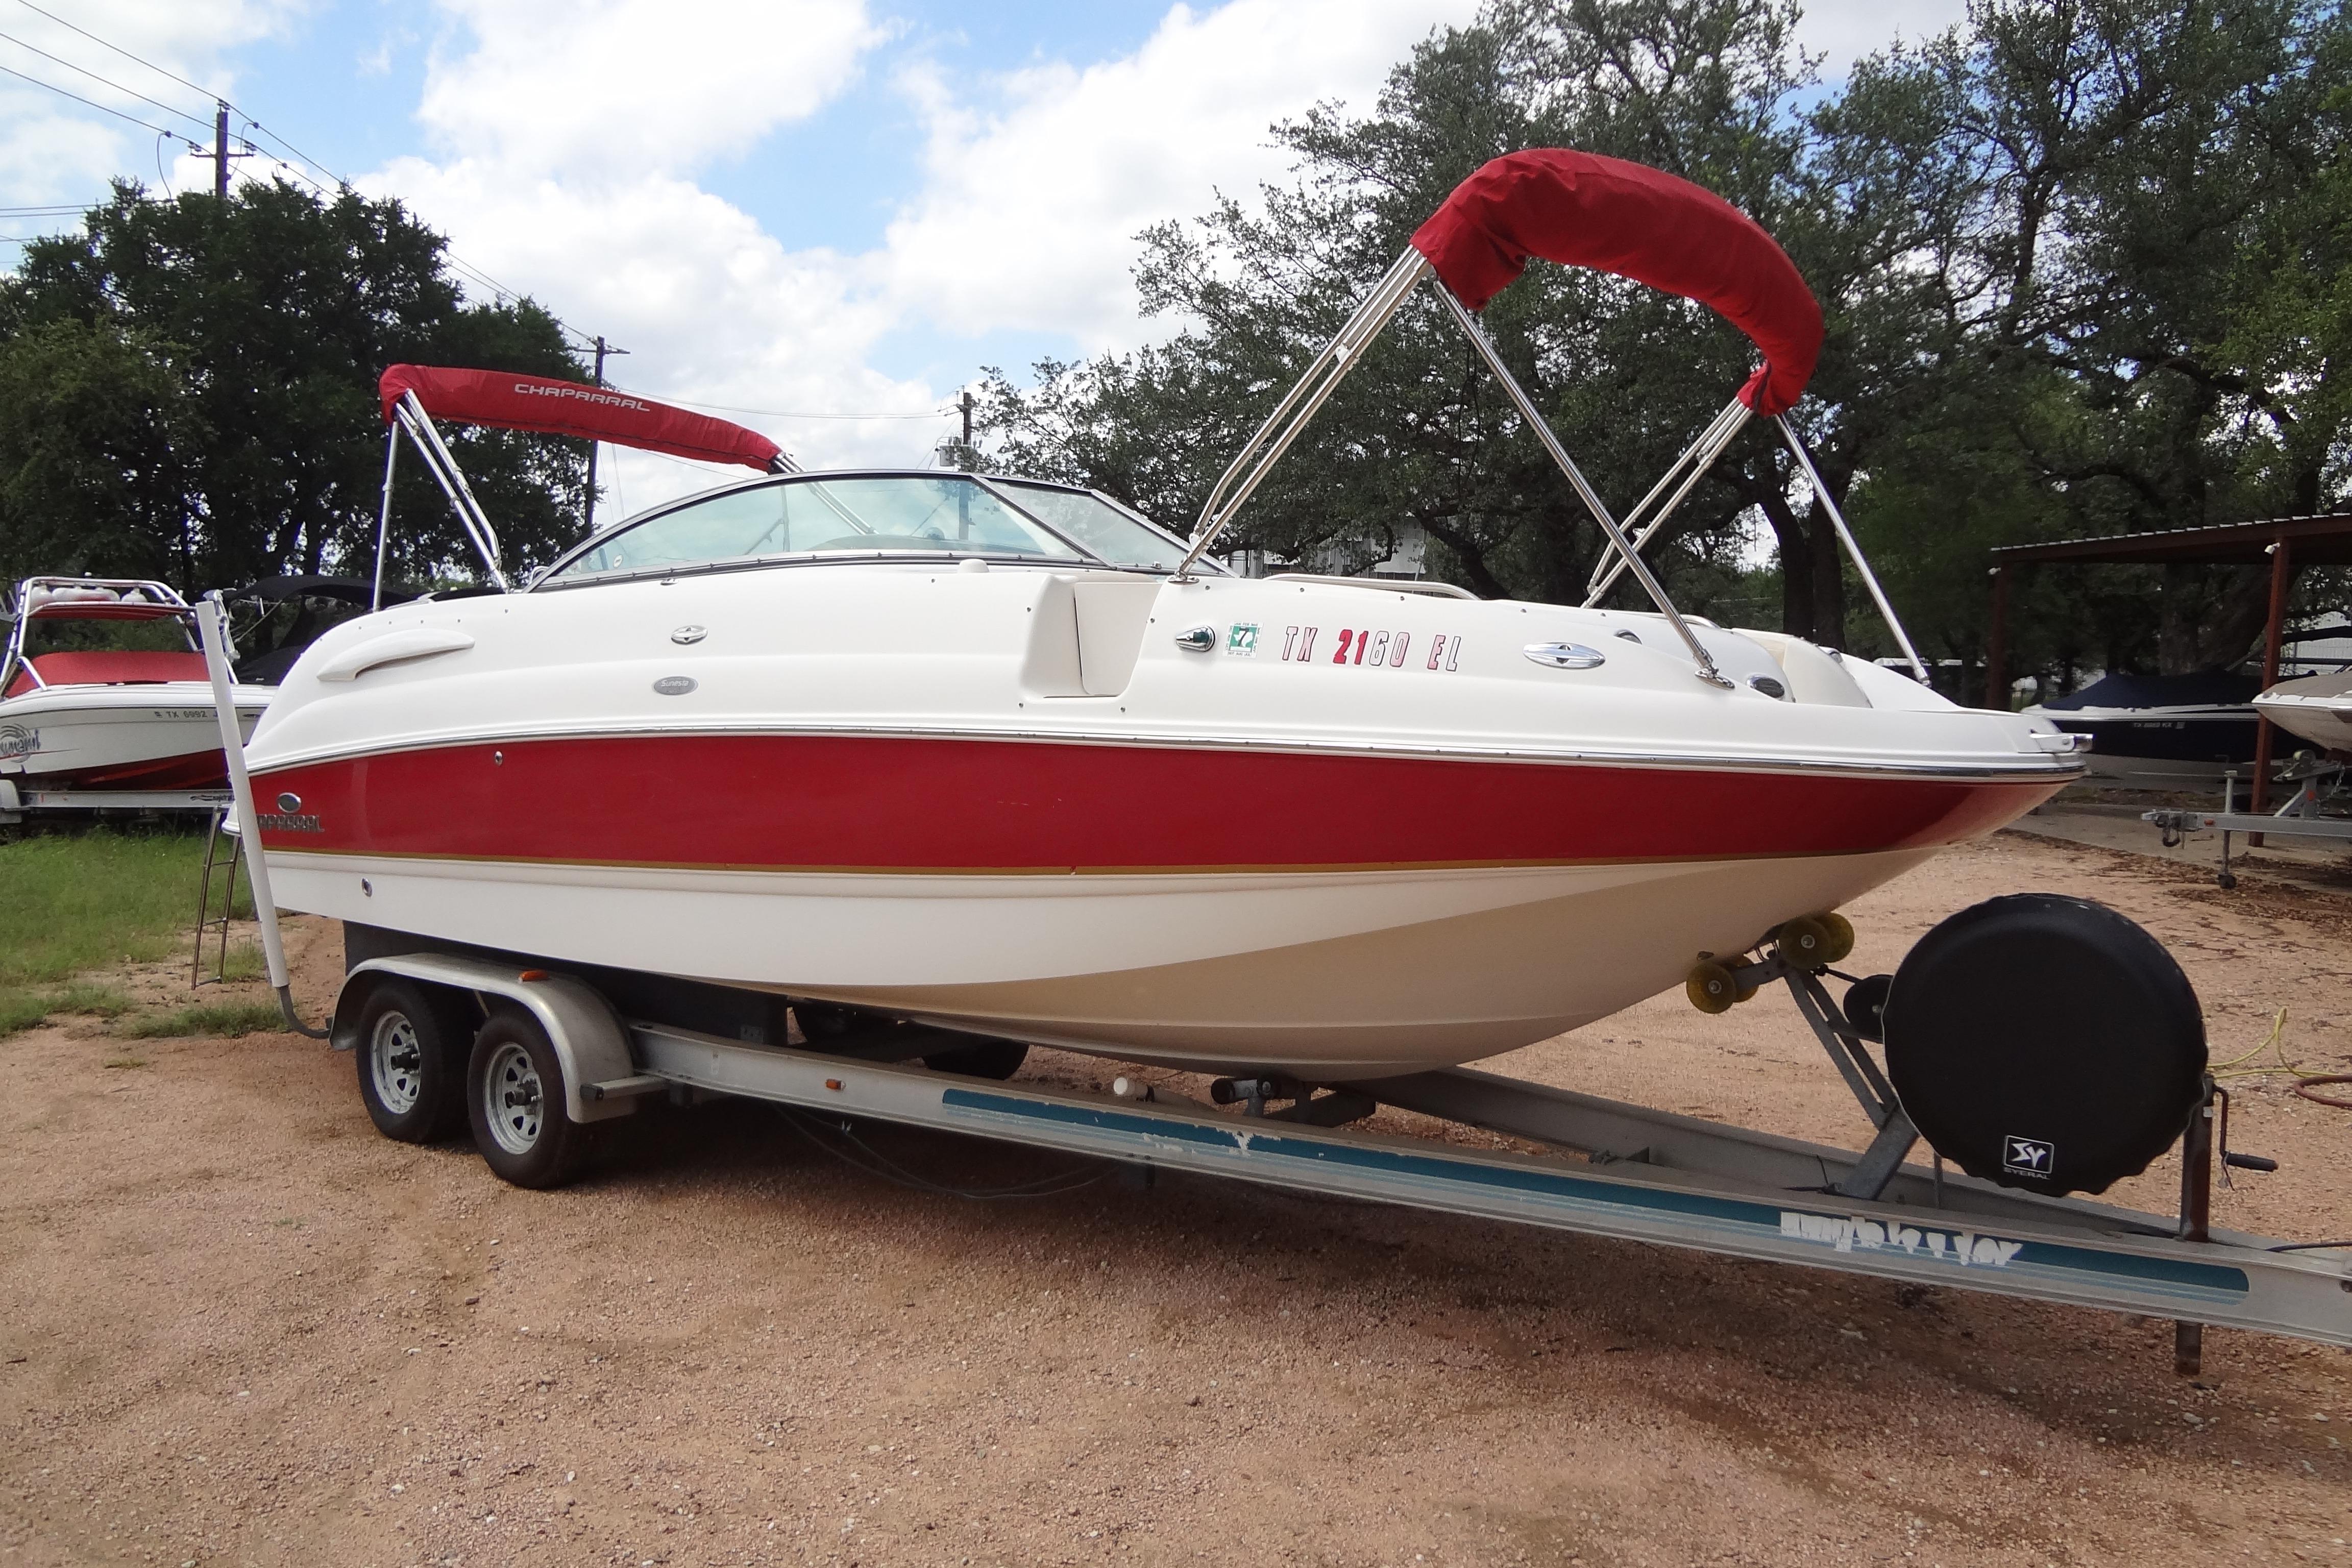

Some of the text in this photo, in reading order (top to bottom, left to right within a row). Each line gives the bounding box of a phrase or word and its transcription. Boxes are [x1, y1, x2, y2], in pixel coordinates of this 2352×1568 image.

[514, 384, 650, 411] CHAPARRAL
[1238, 627, 1249, 647] 7
[1282, 626, 1317, 662] TX
[1333, 629, 1410, 667] 2160
[1427, 635, 1461, 671] EL
[256, 814, 325, 832] APARRAL
